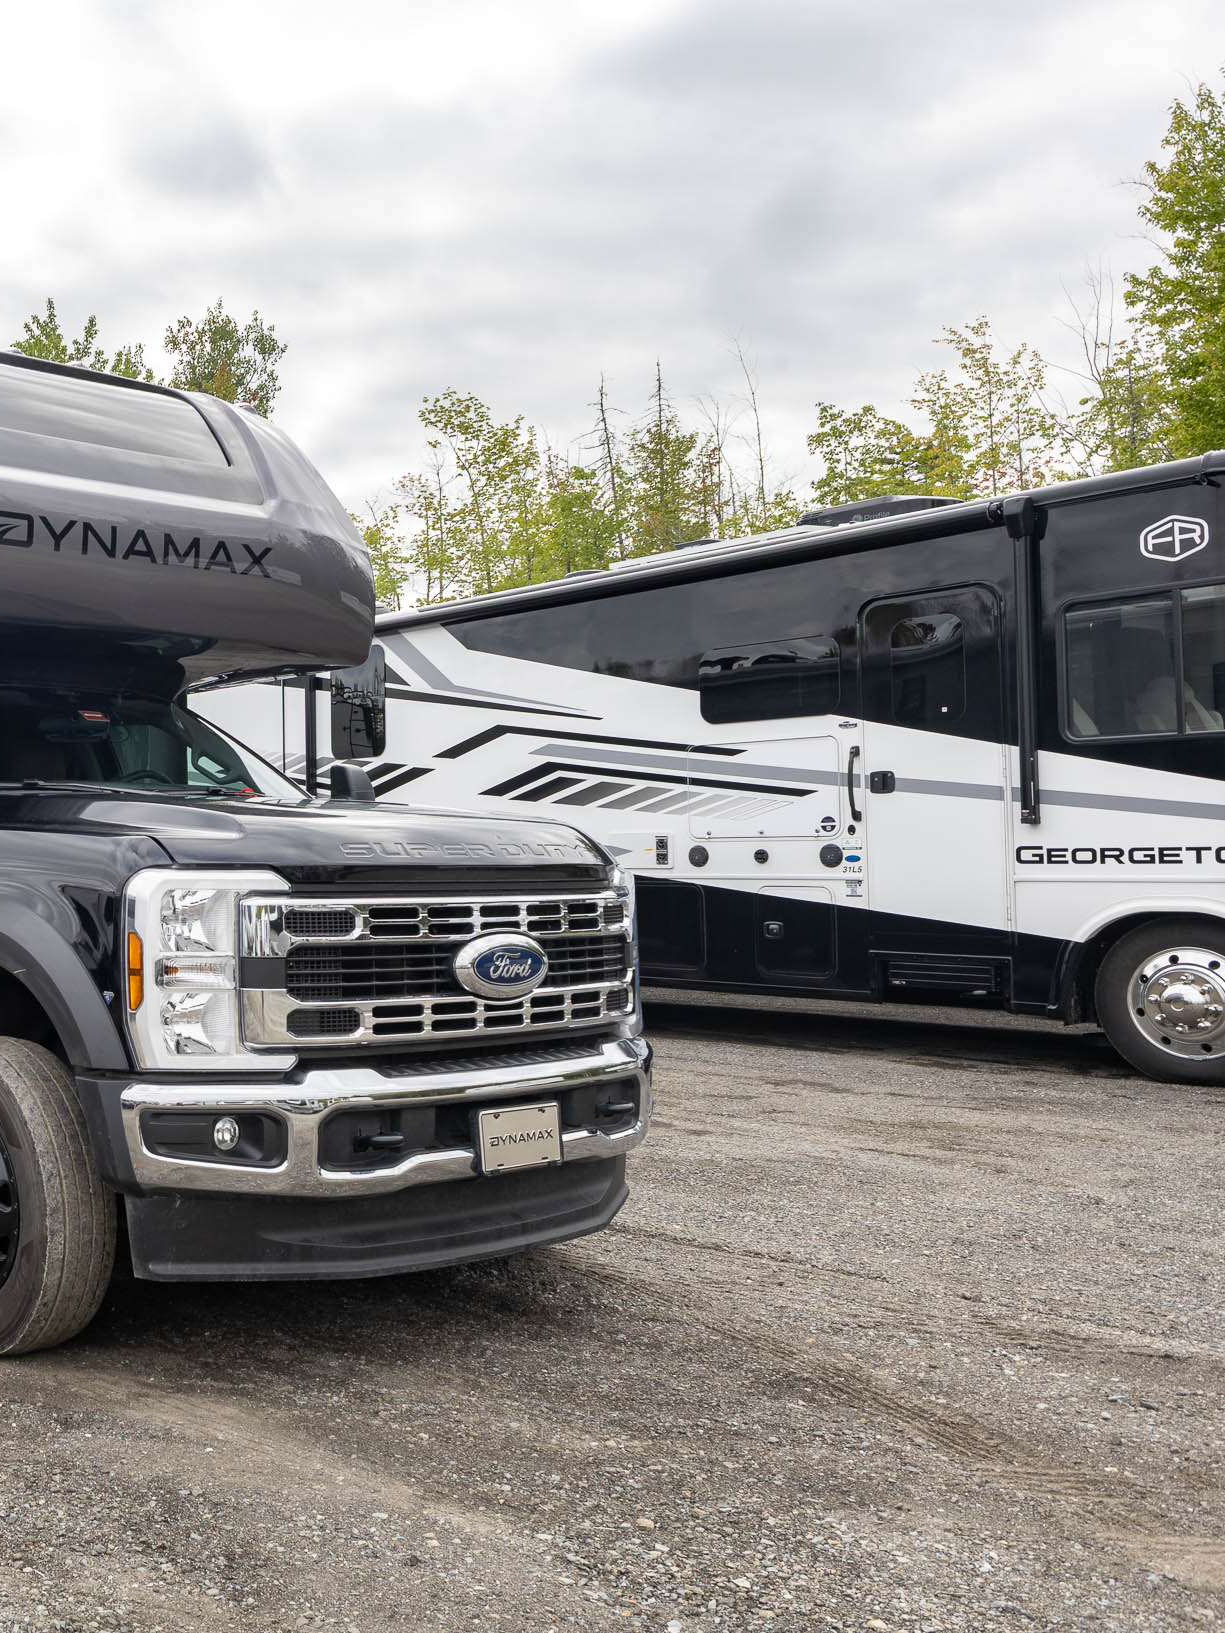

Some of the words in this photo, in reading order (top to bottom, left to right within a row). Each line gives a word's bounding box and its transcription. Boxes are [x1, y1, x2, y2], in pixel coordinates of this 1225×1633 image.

[339, 841, 496, 858] SUPER
[495, 842, 584, 858] DUTY
[489, 952, 532, 978] Ford
[489, 1128, 554, 1147] DYNAMAX
